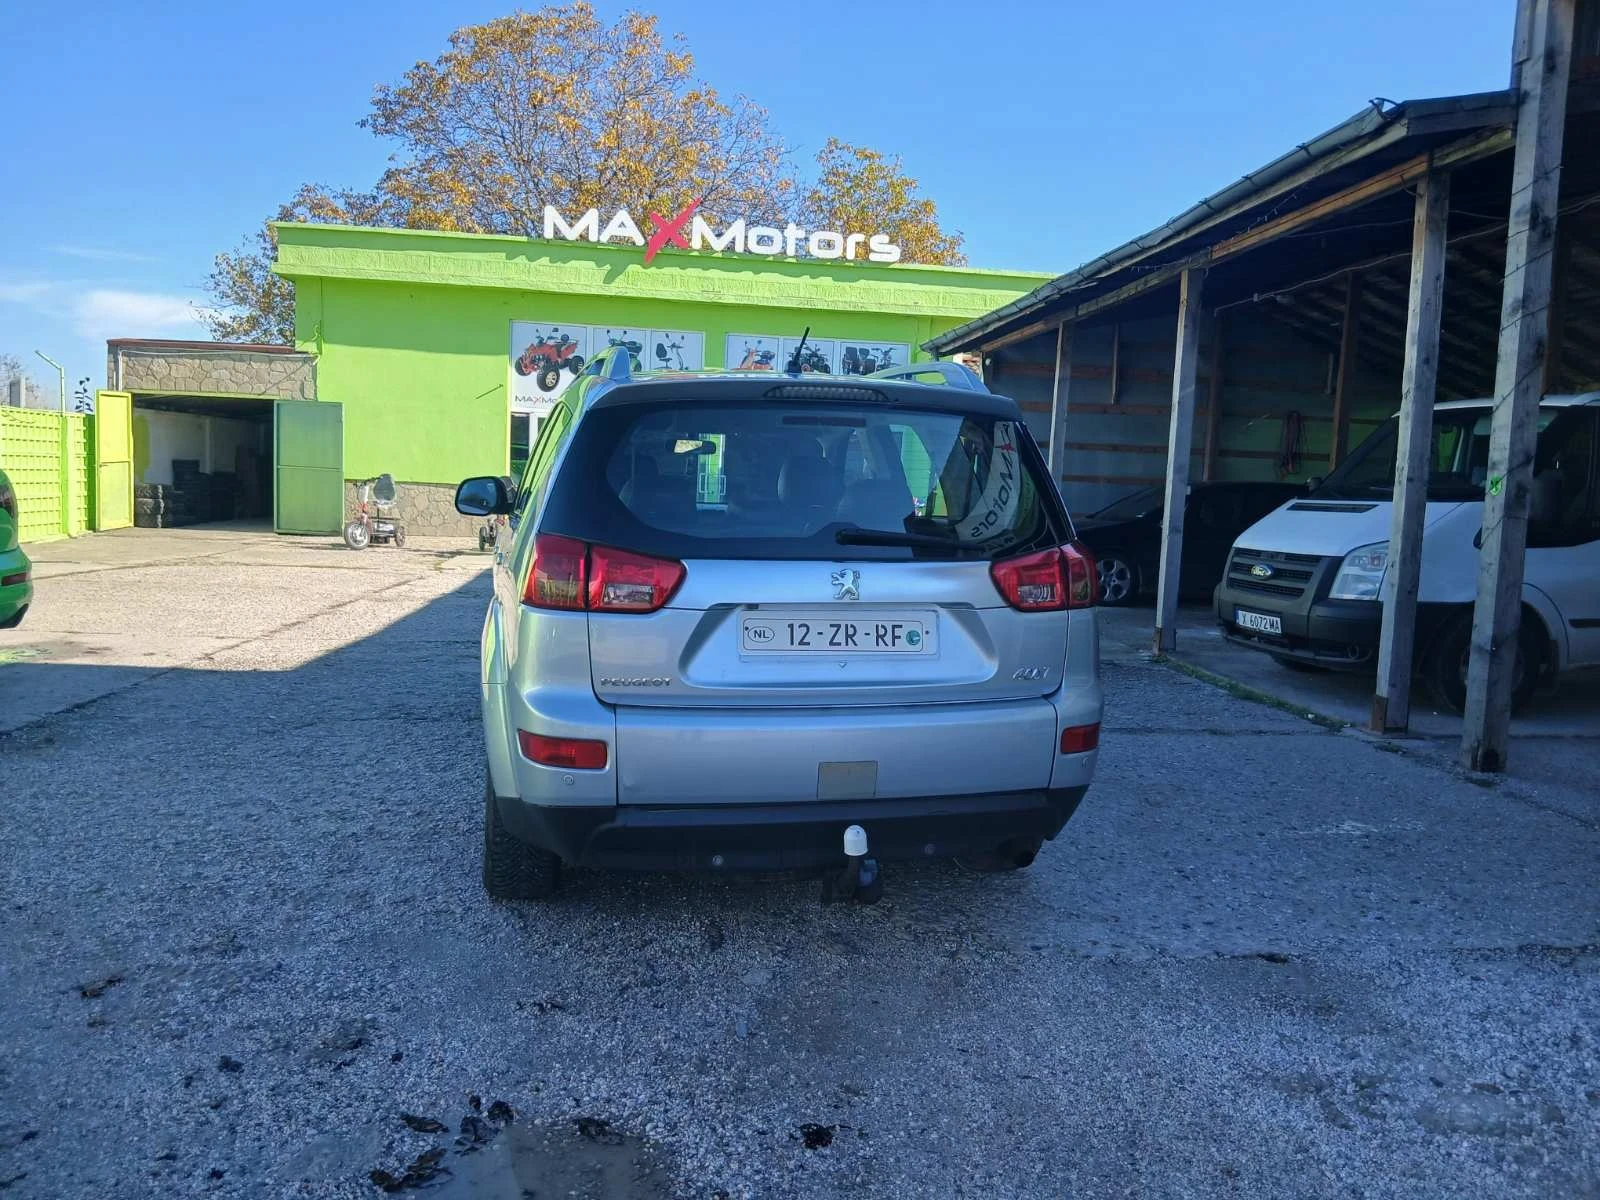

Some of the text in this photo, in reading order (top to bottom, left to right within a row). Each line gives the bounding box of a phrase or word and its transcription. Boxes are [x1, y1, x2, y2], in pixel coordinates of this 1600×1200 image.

[753, 623, 903, 647] NL 12-ZR-RF
[600, 677, 672, 687] PEUGEOT
